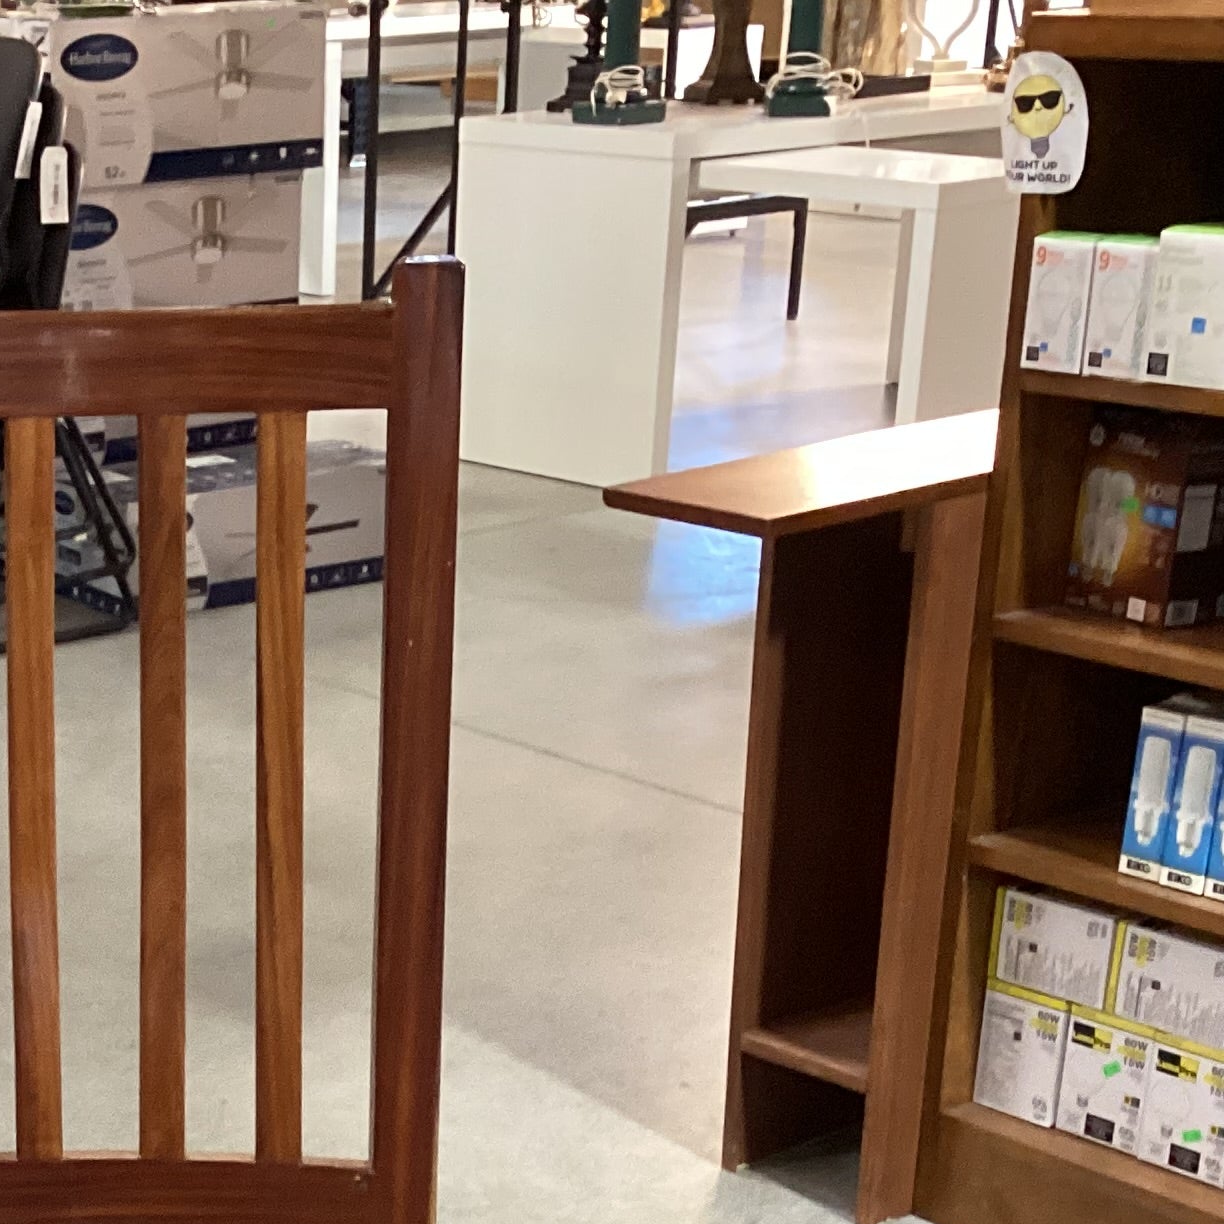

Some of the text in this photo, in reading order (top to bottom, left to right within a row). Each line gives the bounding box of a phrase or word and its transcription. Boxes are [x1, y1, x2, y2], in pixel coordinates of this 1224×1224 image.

[1011, 160, 1058, 169] LIGHT UP
[1027, 172, 1071, 183] WORLD!
